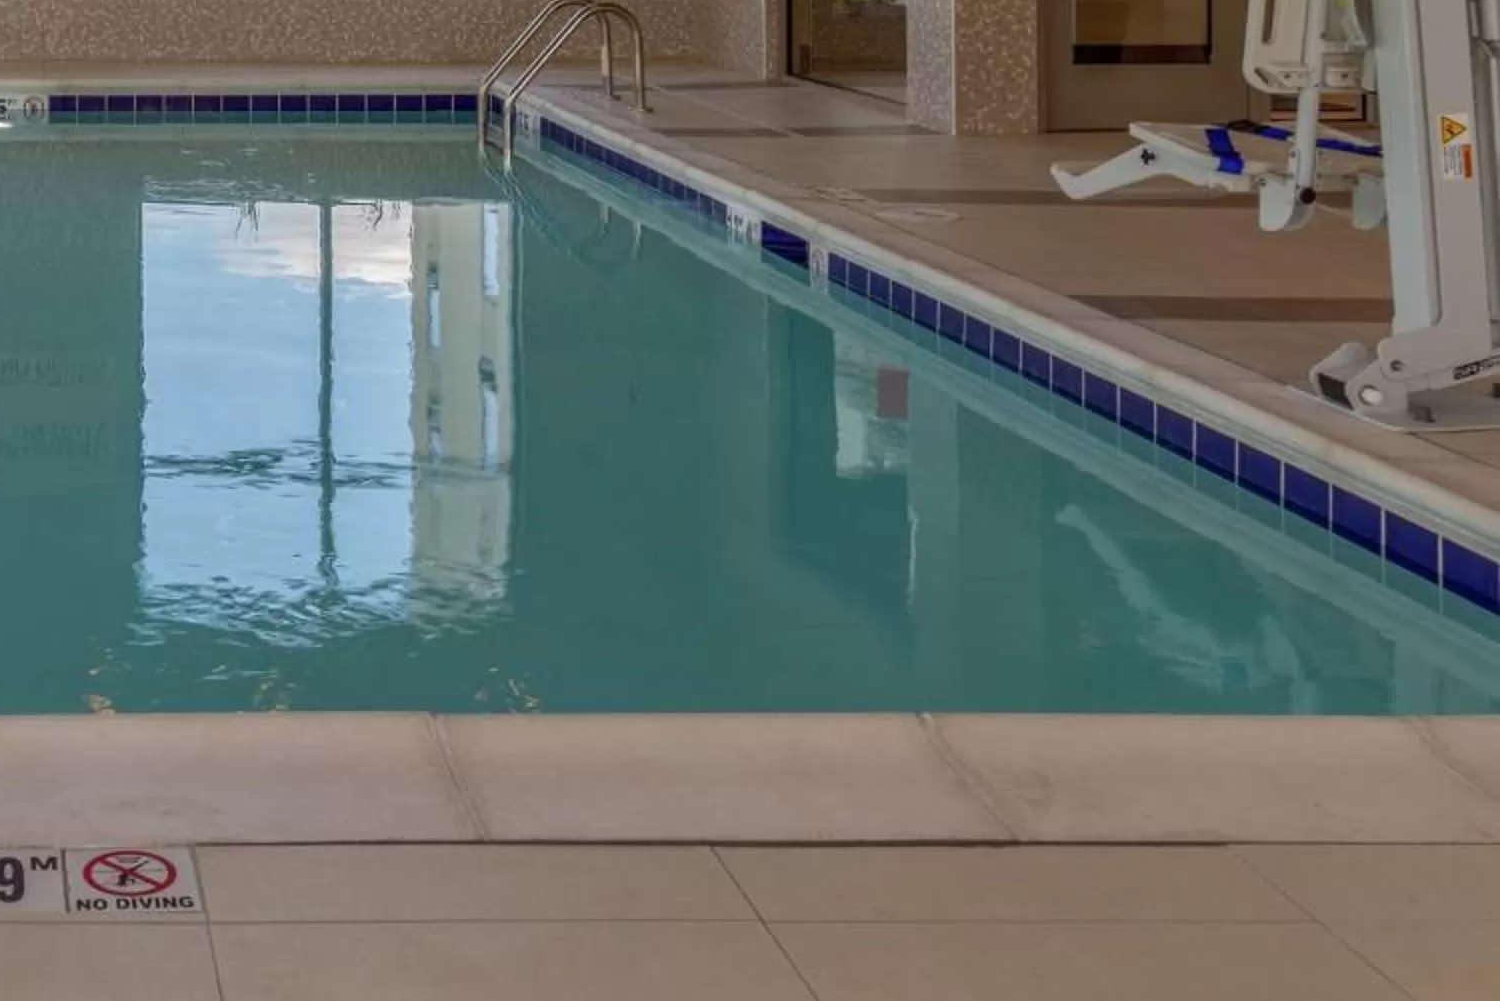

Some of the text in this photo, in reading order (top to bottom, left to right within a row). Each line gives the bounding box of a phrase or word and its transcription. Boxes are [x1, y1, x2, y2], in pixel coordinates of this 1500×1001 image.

[30, 856, 58, 872] M
[76, 894, 195, 912] NO DIVING
